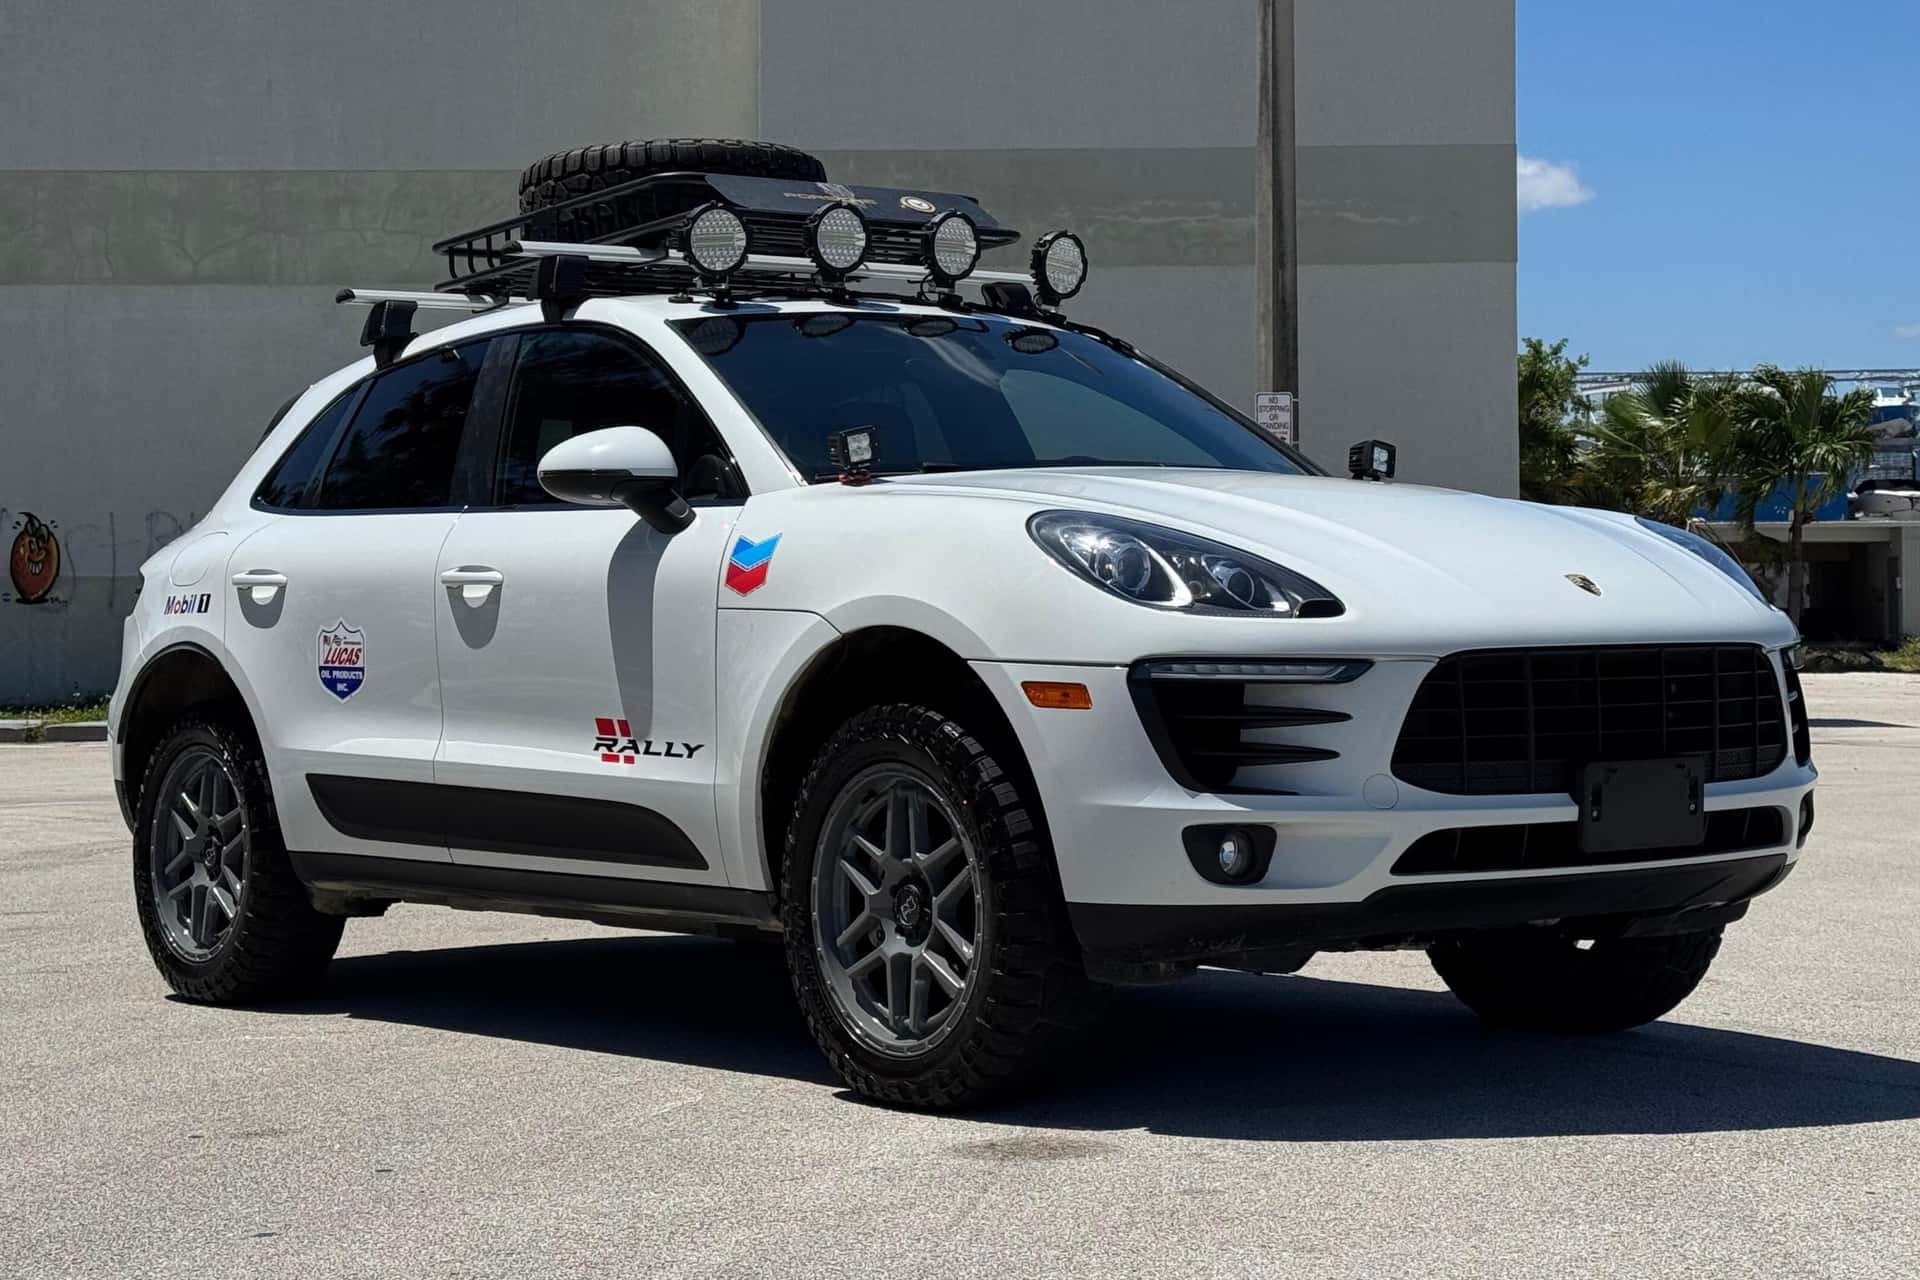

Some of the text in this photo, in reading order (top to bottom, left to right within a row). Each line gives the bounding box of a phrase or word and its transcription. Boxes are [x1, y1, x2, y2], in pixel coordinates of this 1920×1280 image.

[1268, 396, 1279, 404] NO
[1258, 404, 1290, 413] STOPPING
[1268, 413, 1279, 421] OR
[163, 593, 211, 615] Mobil 1
[323, 647, 362, 665] LUCAS
[320, 669, 363, 680] OIL PRODUCTS
[593, 737, 704, 759] RALLY
